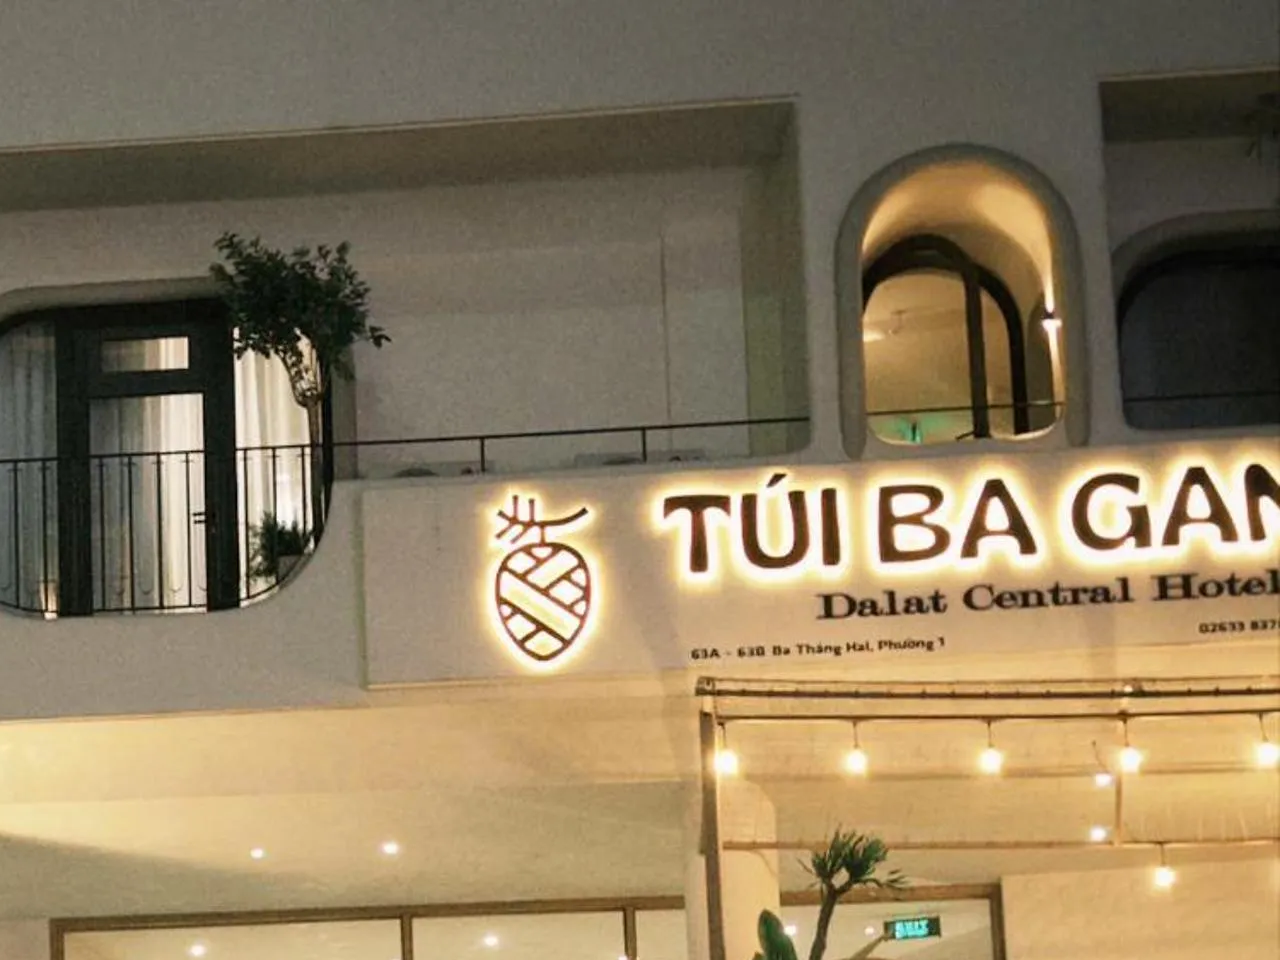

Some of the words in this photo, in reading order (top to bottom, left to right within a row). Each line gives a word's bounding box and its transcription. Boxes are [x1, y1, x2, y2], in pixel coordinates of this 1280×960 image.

[663, 473, 841, 573] TÚI
[878, 478, 1038, 564] BA
[815, 588, 949, 621] Dalat
[963, 576, 1137, 612] Central
[1150, 568, 1280, 602] Hotel
